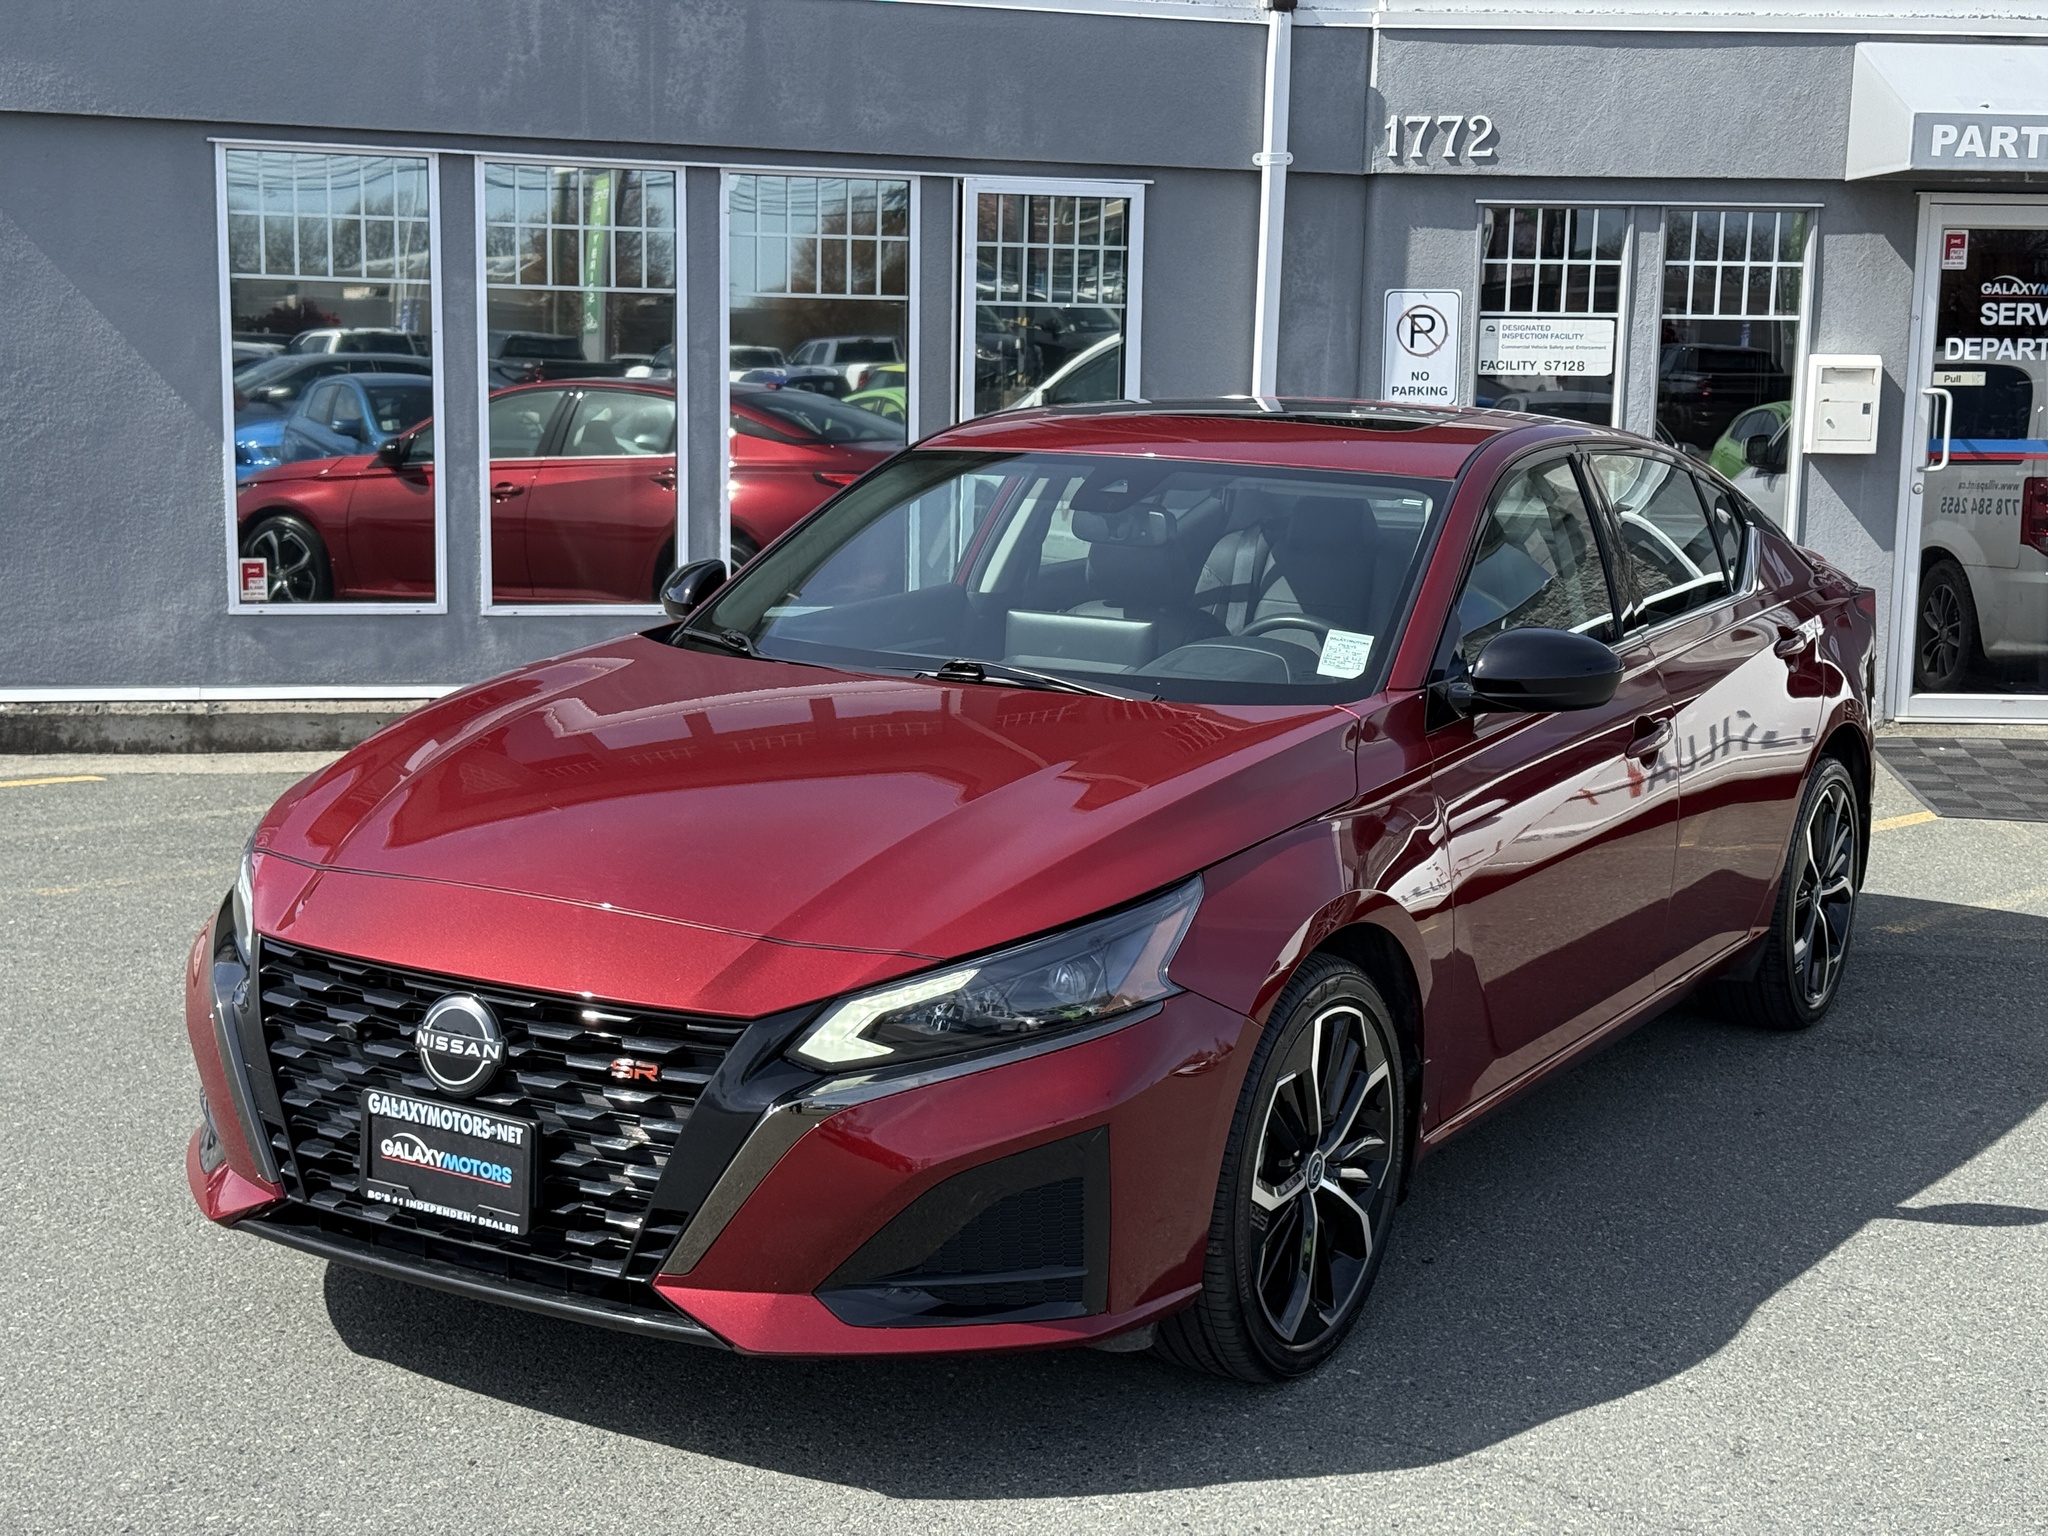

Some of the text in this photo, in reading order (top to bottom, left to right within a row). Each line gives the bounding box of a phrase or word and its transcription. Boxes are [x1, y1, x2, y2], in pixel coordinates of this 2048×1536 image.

[1384, 114, 1495, 157] 1772
[1930, 124, 2048, 159] PART
[1980, 302, 2048, 326] SERV
[1944, 337, 2048, 360] DEPART
[1411, 371, 1430, 381] NO
[1480, 360, 1585, 371] FACILITY S7128
[1391, 386, 1448, 396] PARKING
[1944, 375, 1961, 383] Pull
[416, 1030, 500, 1059] NISSAN
[610, 1058, 658, 1082] SR
[381, 1138, 512, 1184] GALAXYMOTORS
[367, 1190, 391, 1203] BC'S
[405, 1199, 477, 1224] INDEPENDENT
[478, 1217, 519, 1235] DEALER
